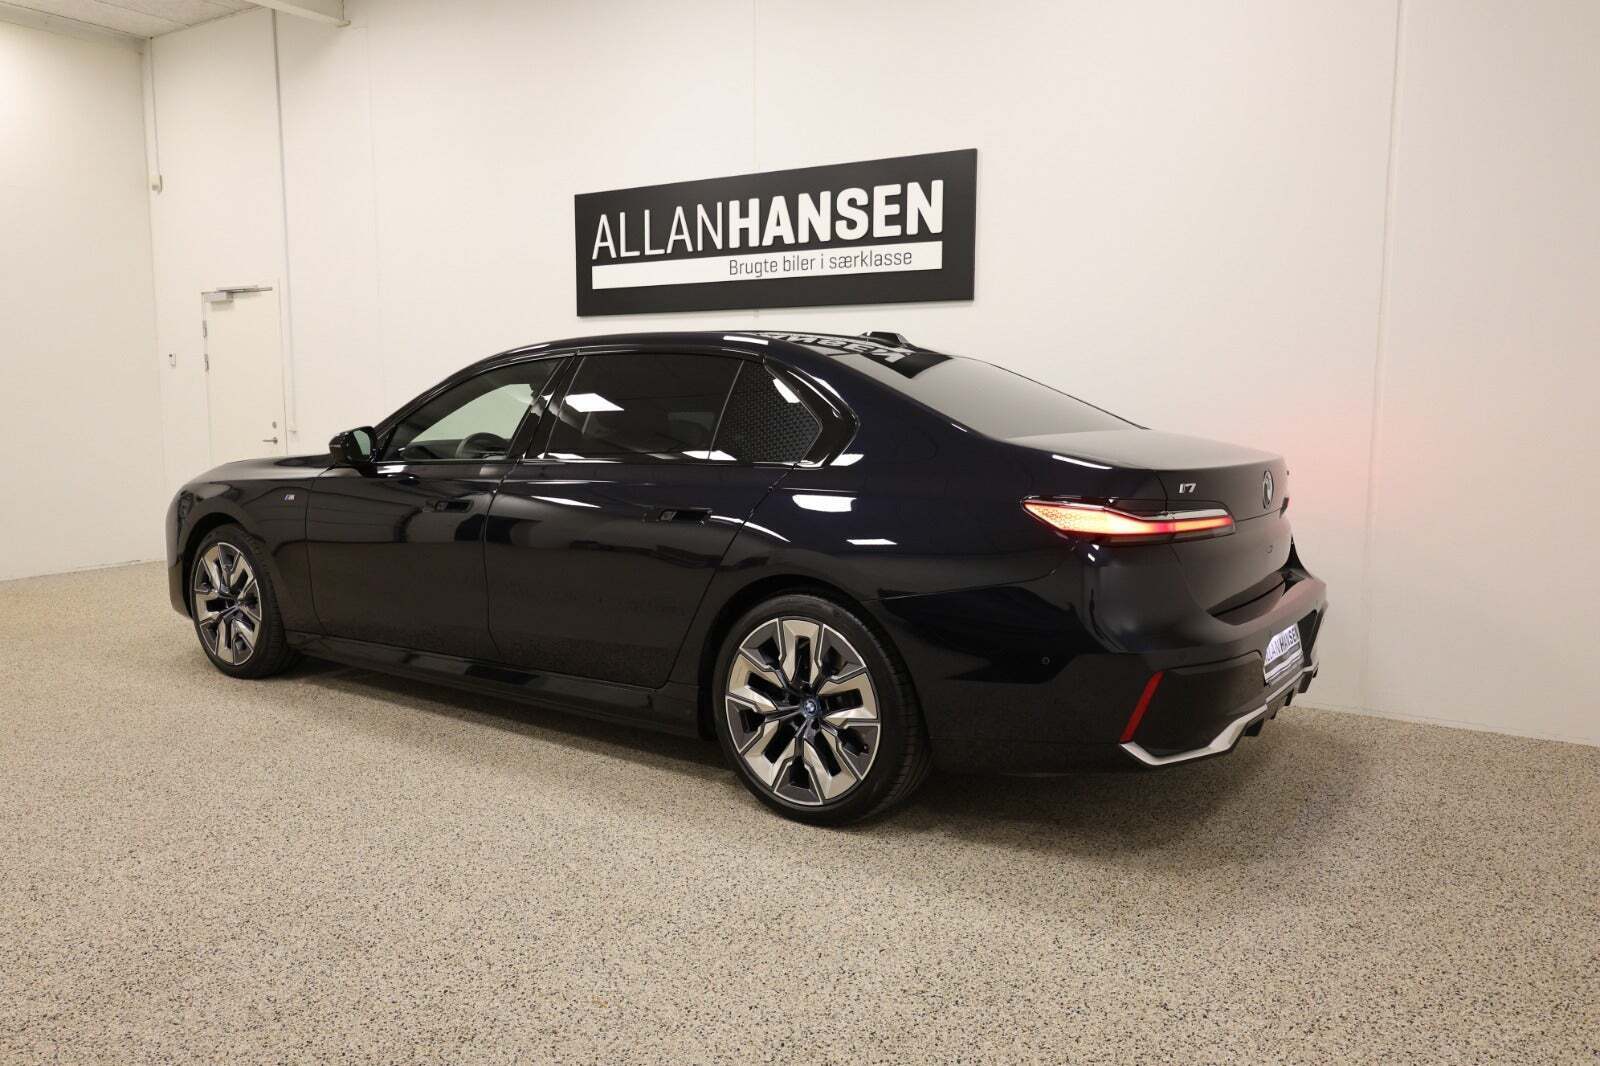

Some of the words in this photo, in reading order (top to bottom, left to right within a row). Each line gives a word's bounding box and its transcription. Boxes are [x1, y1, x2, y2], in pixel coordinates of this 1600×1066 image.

[728, 259, 778, 278] Brugte
[783, 254, 815, 272] biler
[820, 254, 824, 269] i
[828, 249, 913, 269] særklasse
